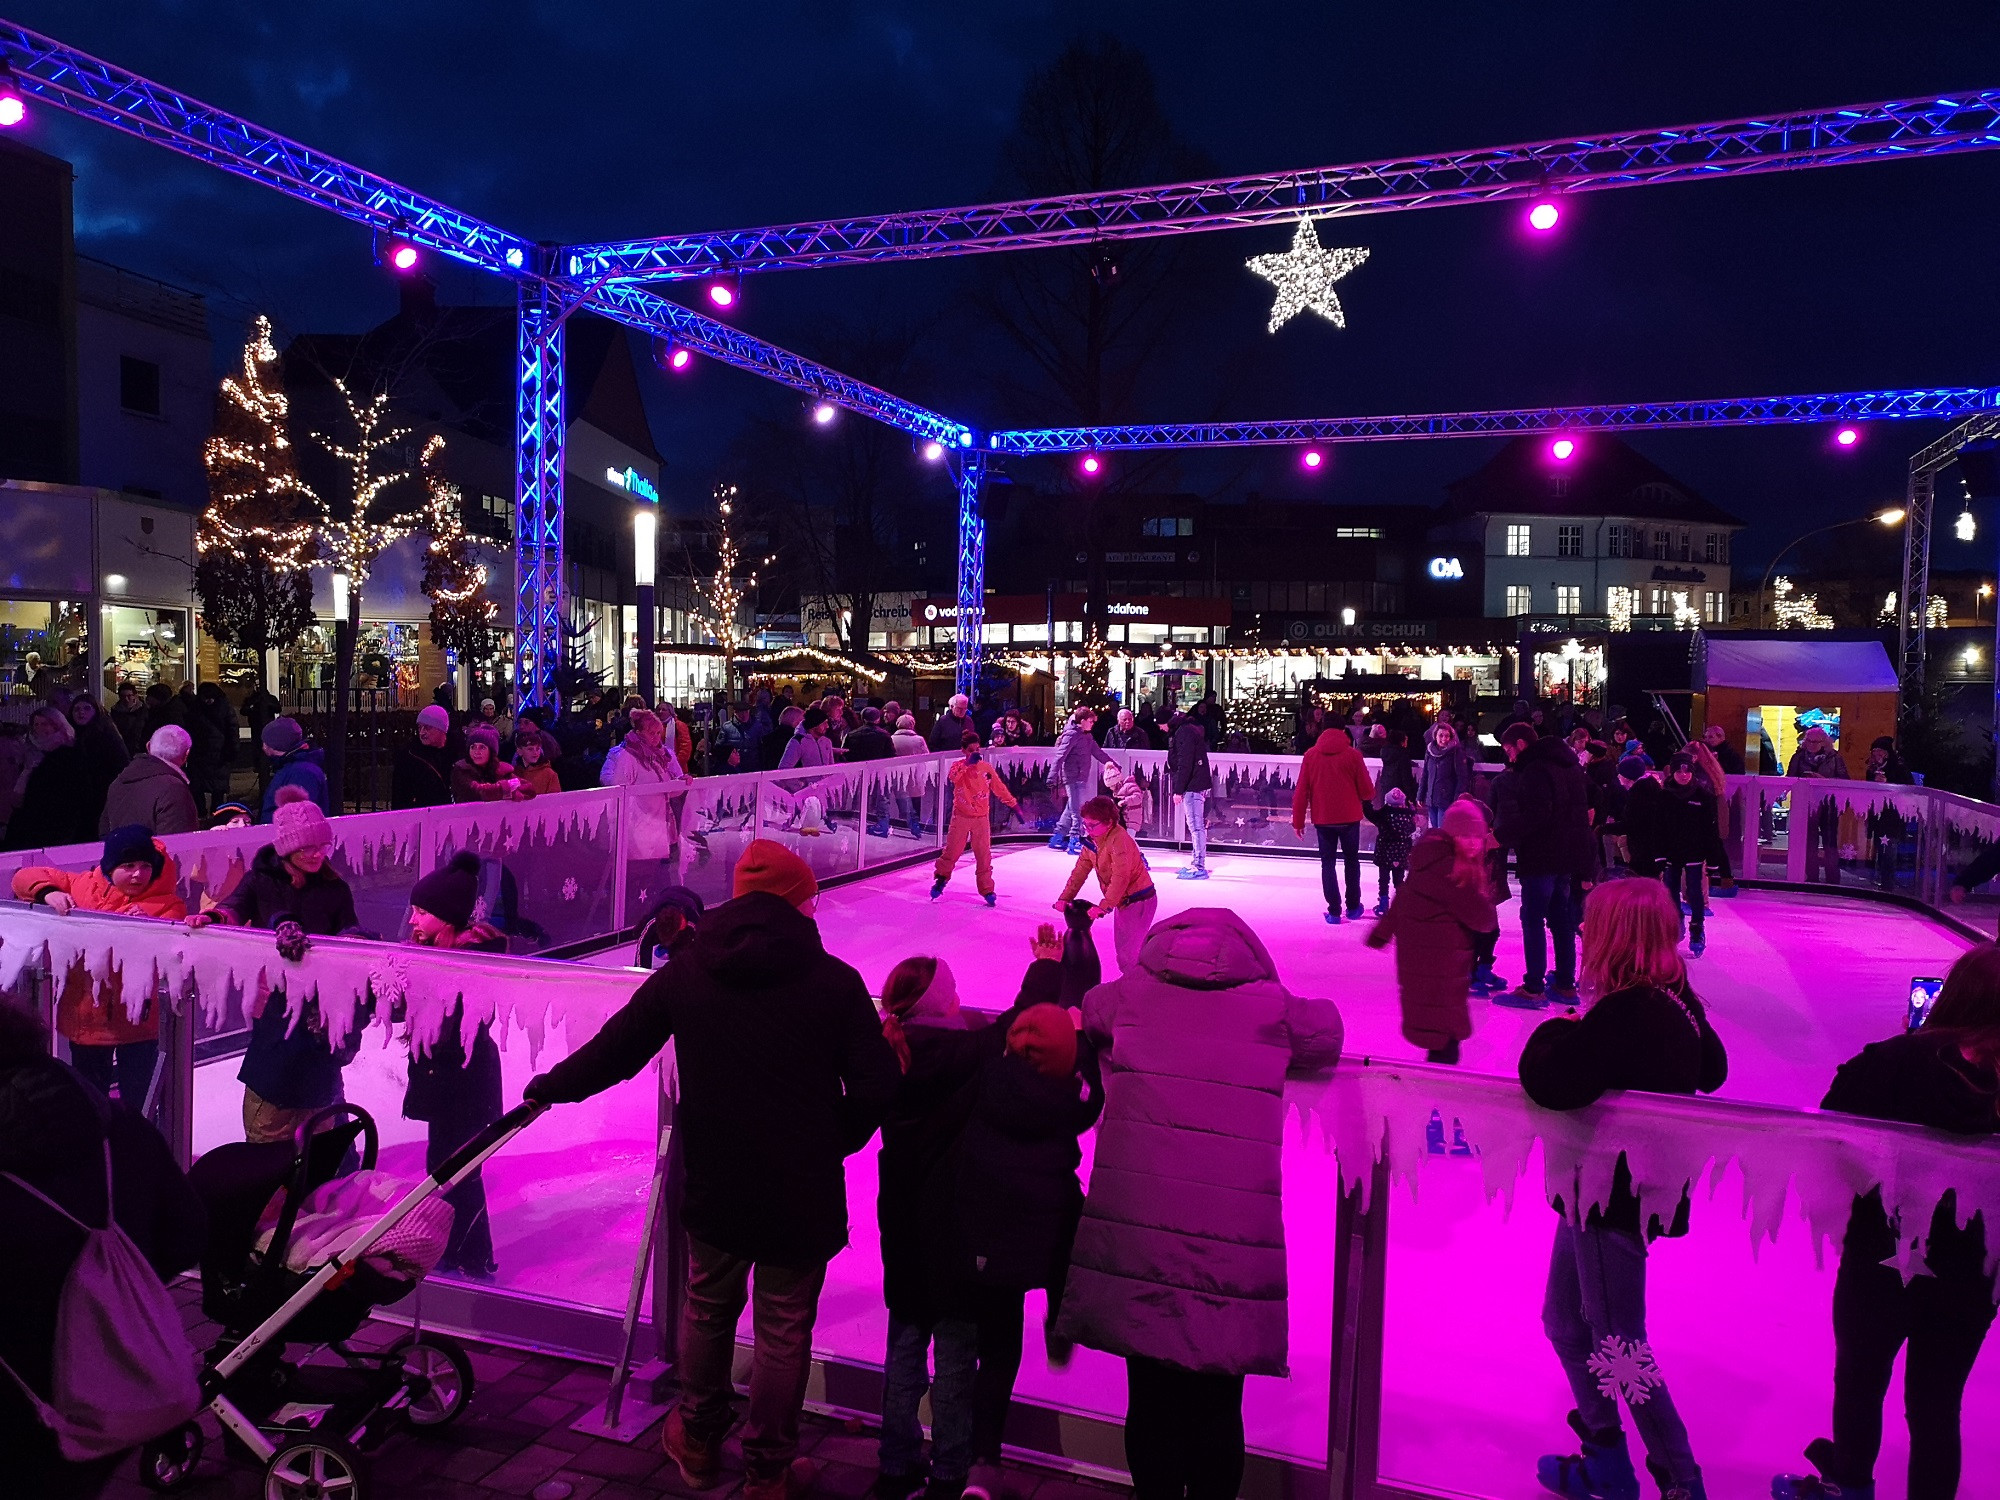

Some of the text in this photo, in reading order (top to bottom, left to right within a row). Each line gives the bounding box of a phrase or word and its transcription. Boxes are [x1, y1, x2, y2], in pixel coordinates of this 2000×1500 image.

[808, 604, 912, 620] Reis chreib
[939, 605, 986, 617] vodoe
[1107, 602, 1149, 615] odafone
[1372, 623, 1426, 637] SCHUH
